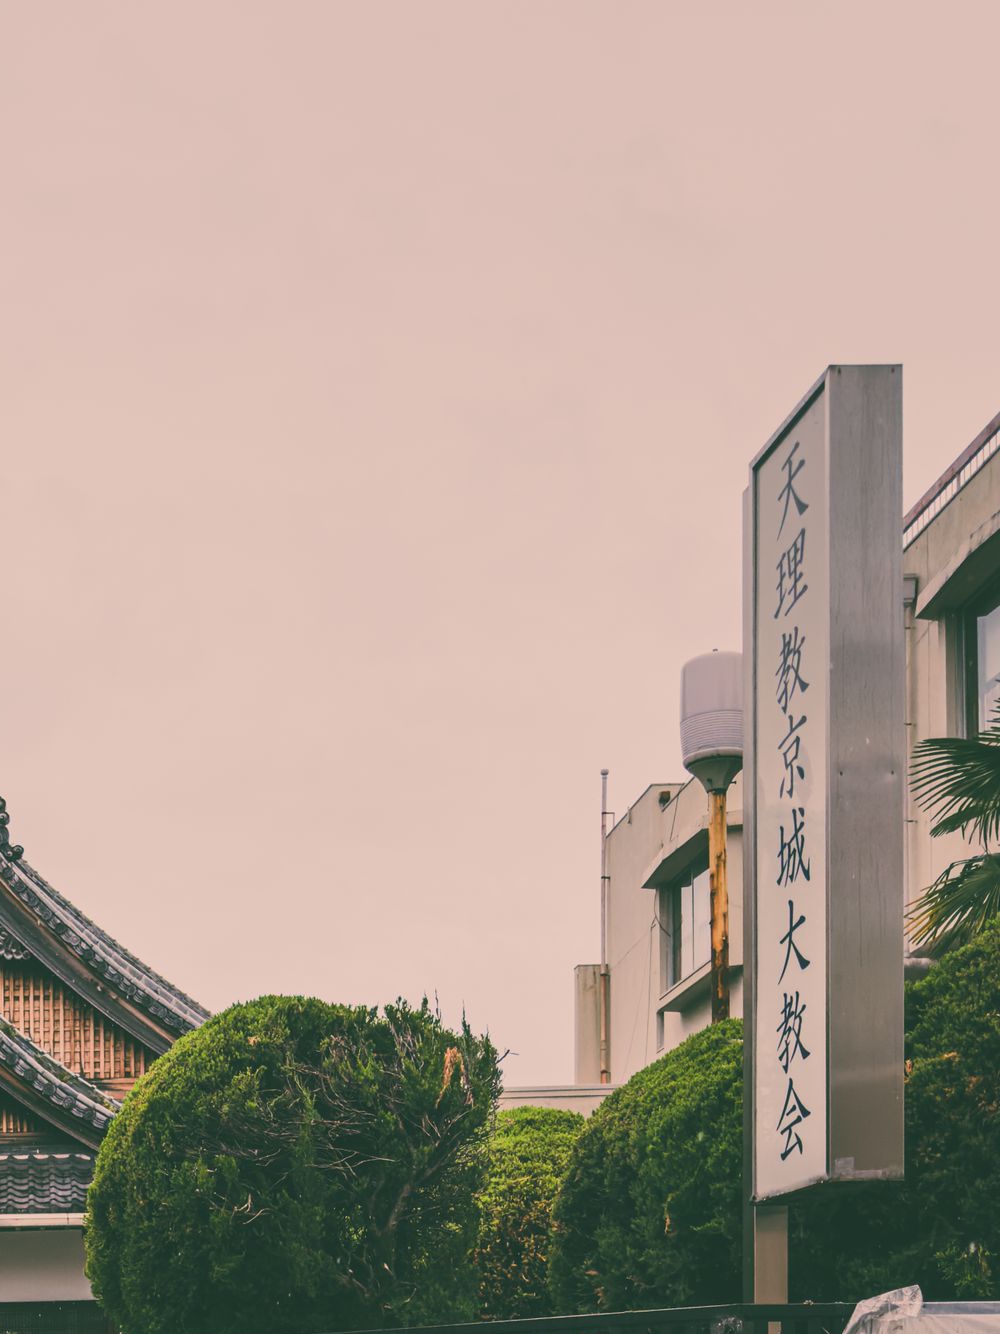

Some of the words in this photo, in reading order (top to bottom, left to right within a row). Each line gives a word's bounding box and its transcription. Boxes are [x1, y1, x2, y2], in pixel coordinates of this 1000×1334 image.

[774, 440, 811, 1161] 天理教京城大教会
